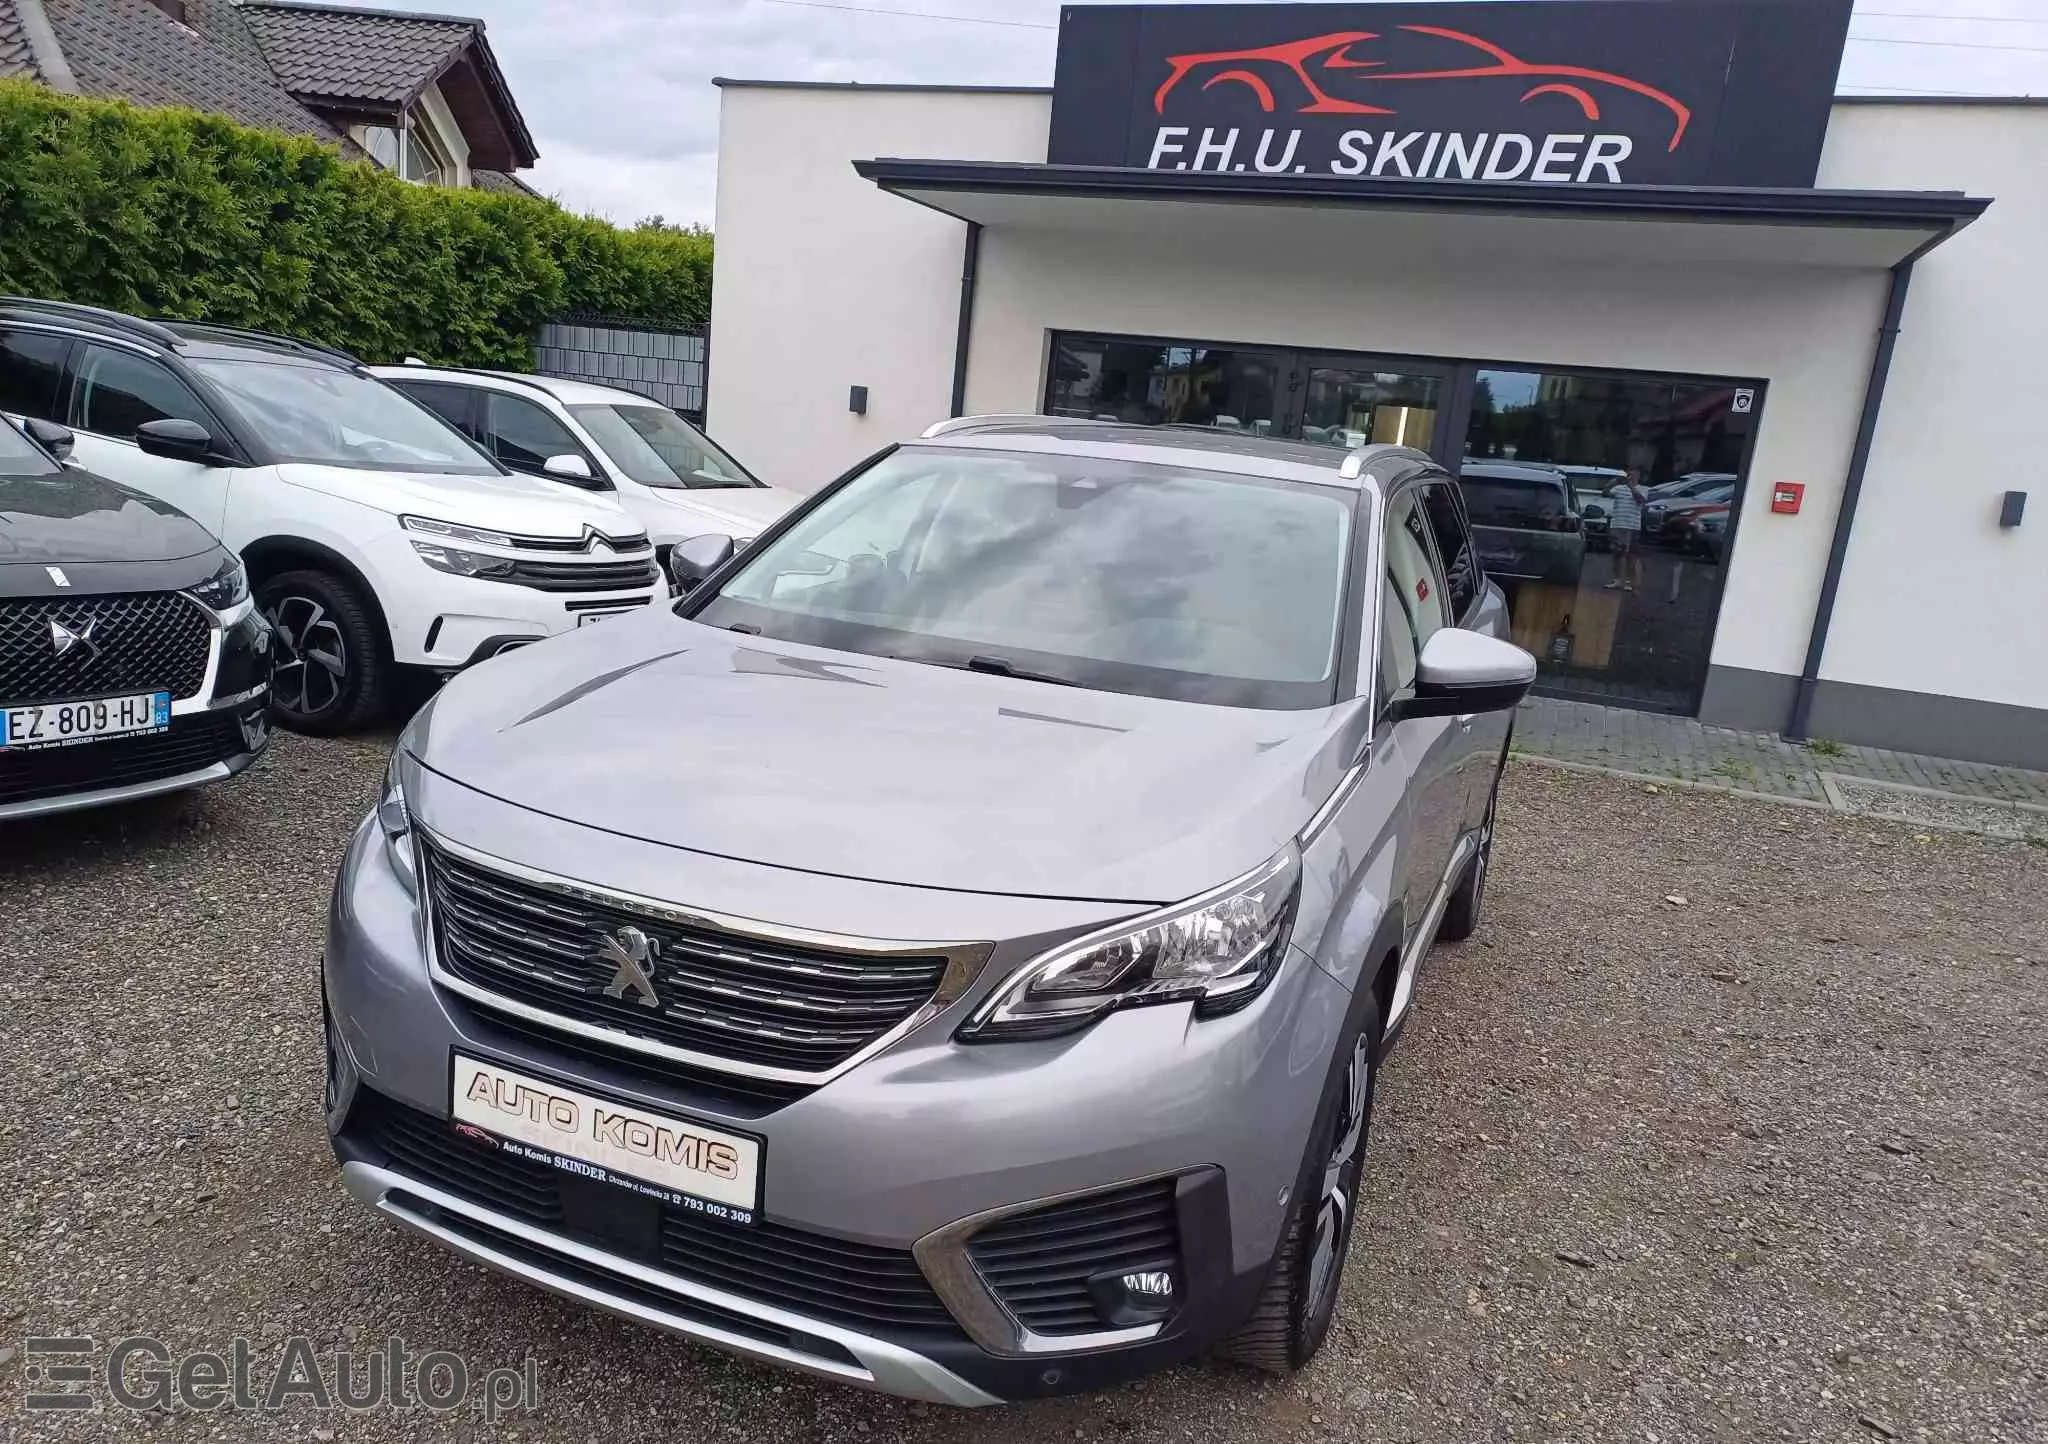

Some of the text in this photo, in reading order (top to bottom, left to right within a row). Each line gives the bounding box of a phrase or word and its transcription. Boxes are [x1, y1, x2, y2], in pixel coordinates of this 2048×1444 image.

[1148, 126, 1633, 184] F.H.U. SKINDER
[9, 698, 149, 741] EZ-809-HJ
[467, 1072, 739, 1181] AUTO KOMIS
[503, 1141, 523, 1155] Auto
[524, 1148, 552, 1164] Komis
[553, 1156, 607, 1182] SKINDER
[684, 1196, 704, 1211] 793
[706, 1203, 728, 1218] 002
[730, 1209, 752, 1224] 309
